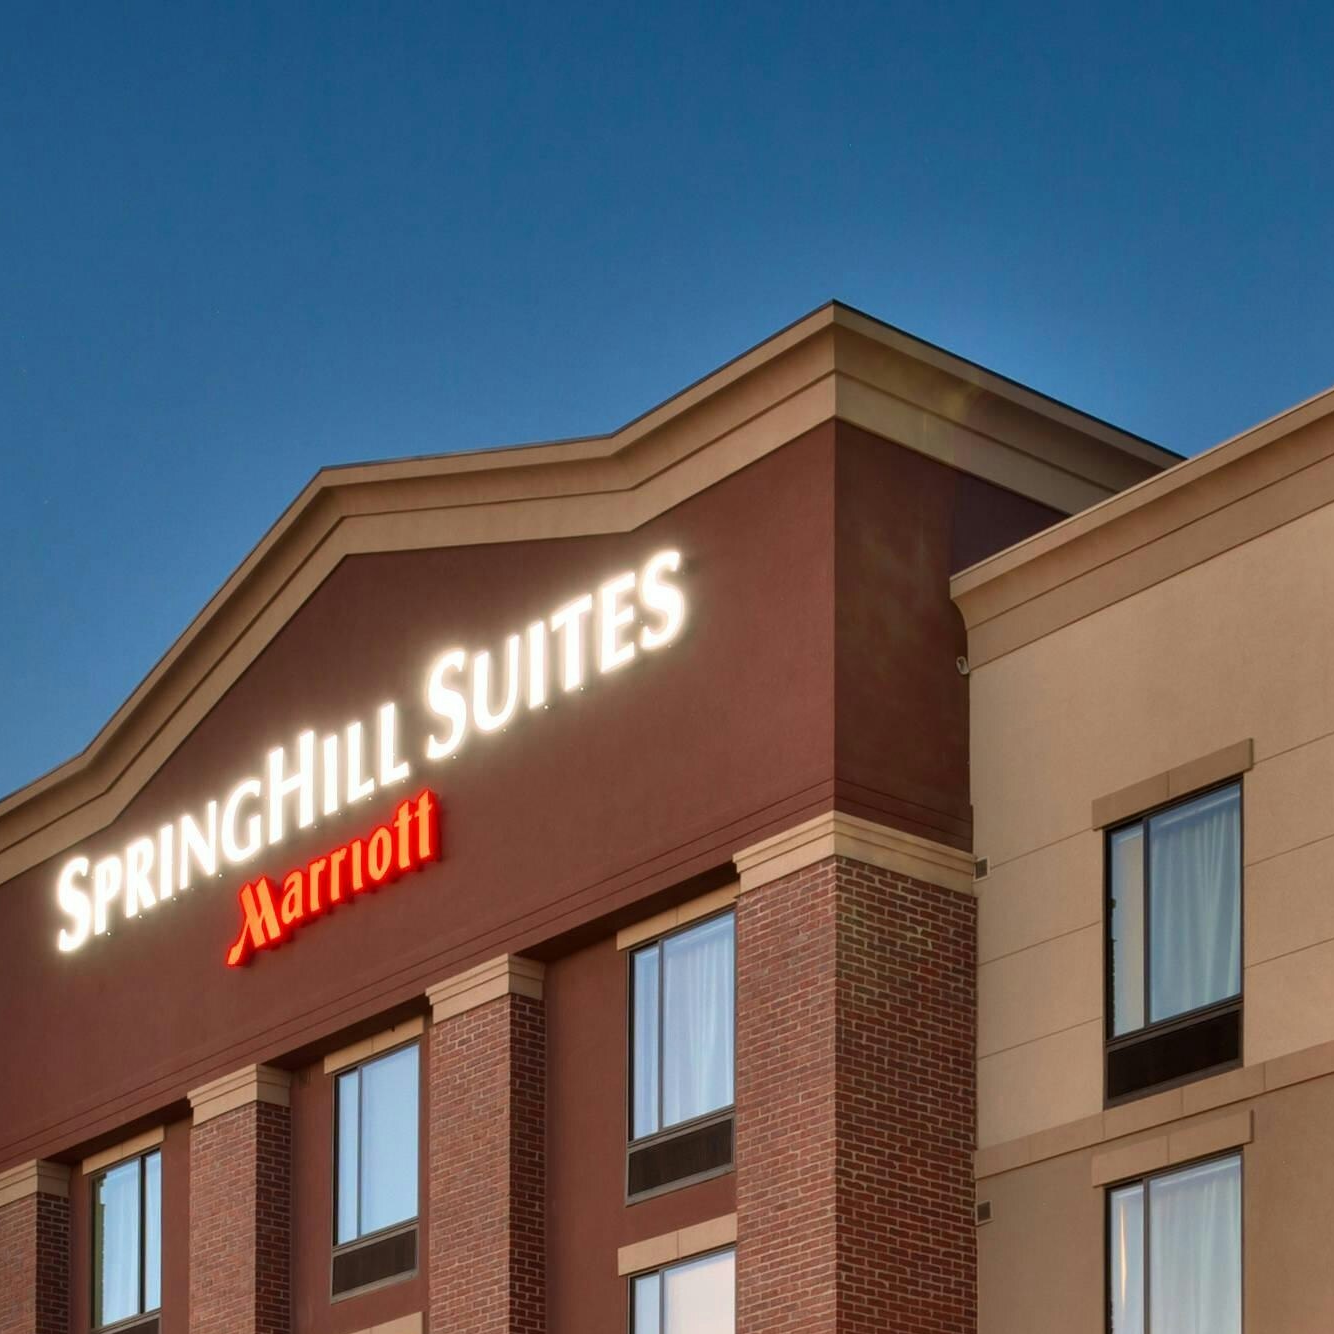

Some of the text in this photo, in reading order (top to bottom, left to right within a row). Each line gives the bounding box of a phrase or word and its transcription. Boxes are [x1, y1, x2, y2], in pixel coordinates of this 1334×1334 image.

[56, 550, 685, 952] SPRINGHILL SUITES
[227, 789, 438, 967] Marriott
